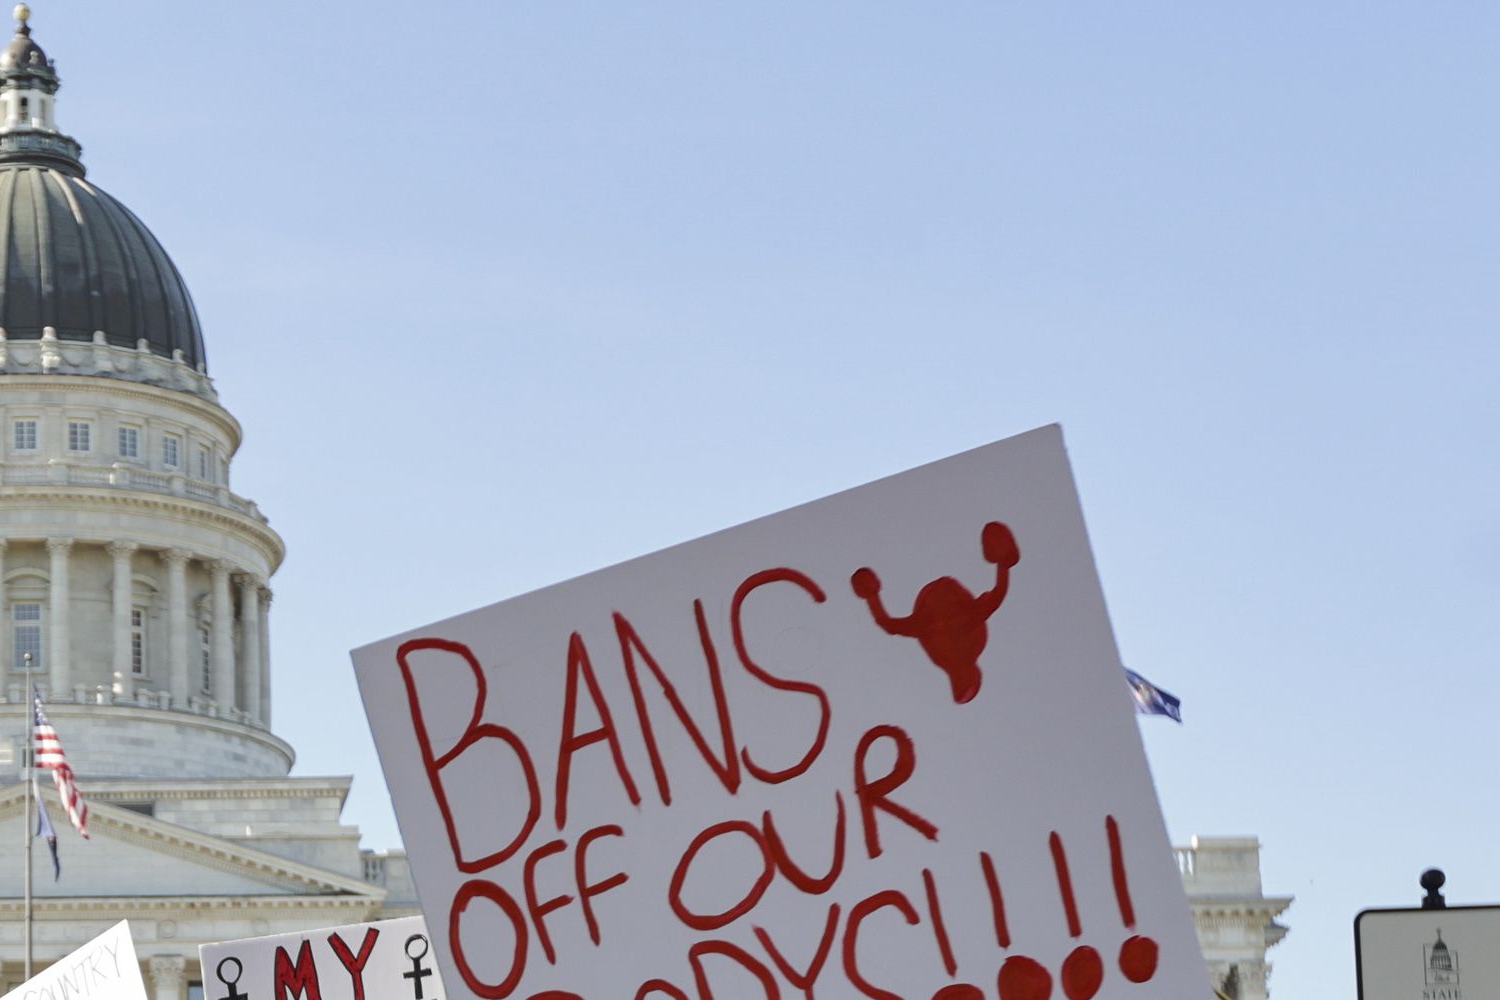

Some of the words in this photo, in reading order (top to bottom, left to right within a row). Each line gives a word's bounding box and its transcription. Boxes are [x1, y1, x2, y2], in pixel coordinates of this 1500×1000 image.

[396, 566, 831, 873] BANS
[449, 824, 629, 1000] OFF
[669, 724, 939, 931] OUR
[1422, 988, 1463, 1000] STATE
